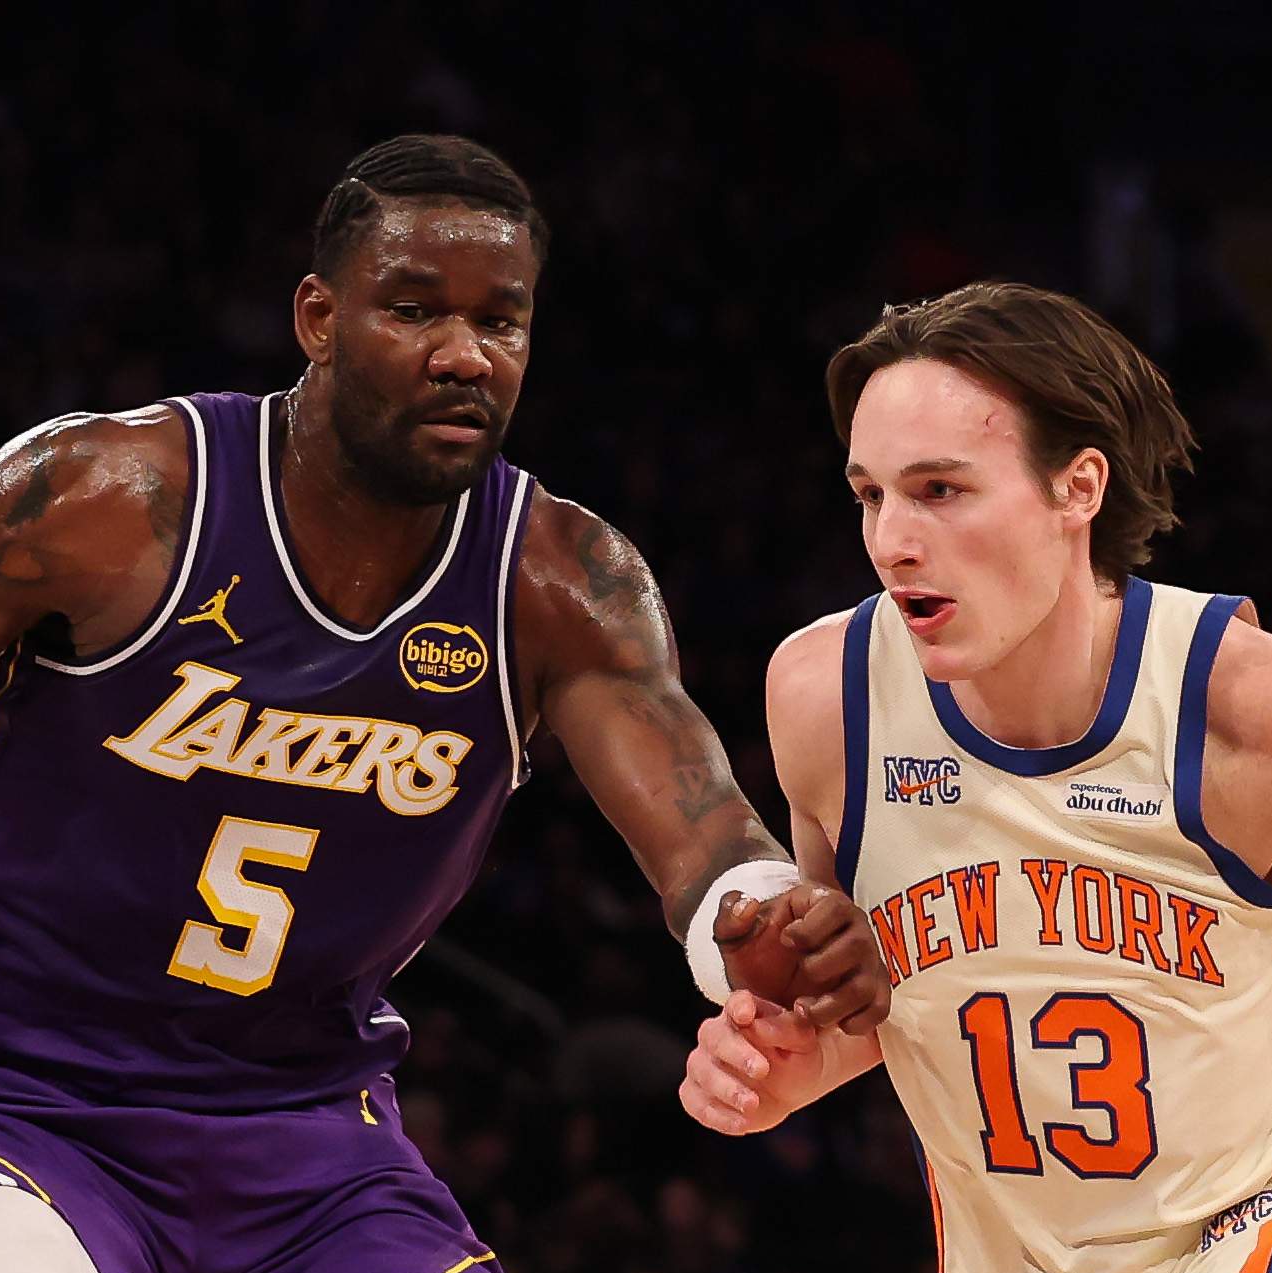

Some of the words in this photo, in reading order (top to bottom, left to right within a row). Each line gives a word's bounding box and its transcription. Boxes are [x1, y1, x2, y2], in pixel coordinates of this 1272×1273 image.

[407, 640, 482, 674] bibigo
[417, 663, 448, 677] 비비고
[102, 661, 474, 816] LAKERS
[883, 756, 961, 806] NYC
[1066, 793, 1104, 811] abu
[1107, 797, 1164, 816] dhabi
[1070, 783, 1122, 794] experience
[167, 815, 320, 996] 5
[869, 860, 1001, 990] NEW
[1021, 858, 1224, 987] YORK
[957, 991, 1159, 1180] 13
